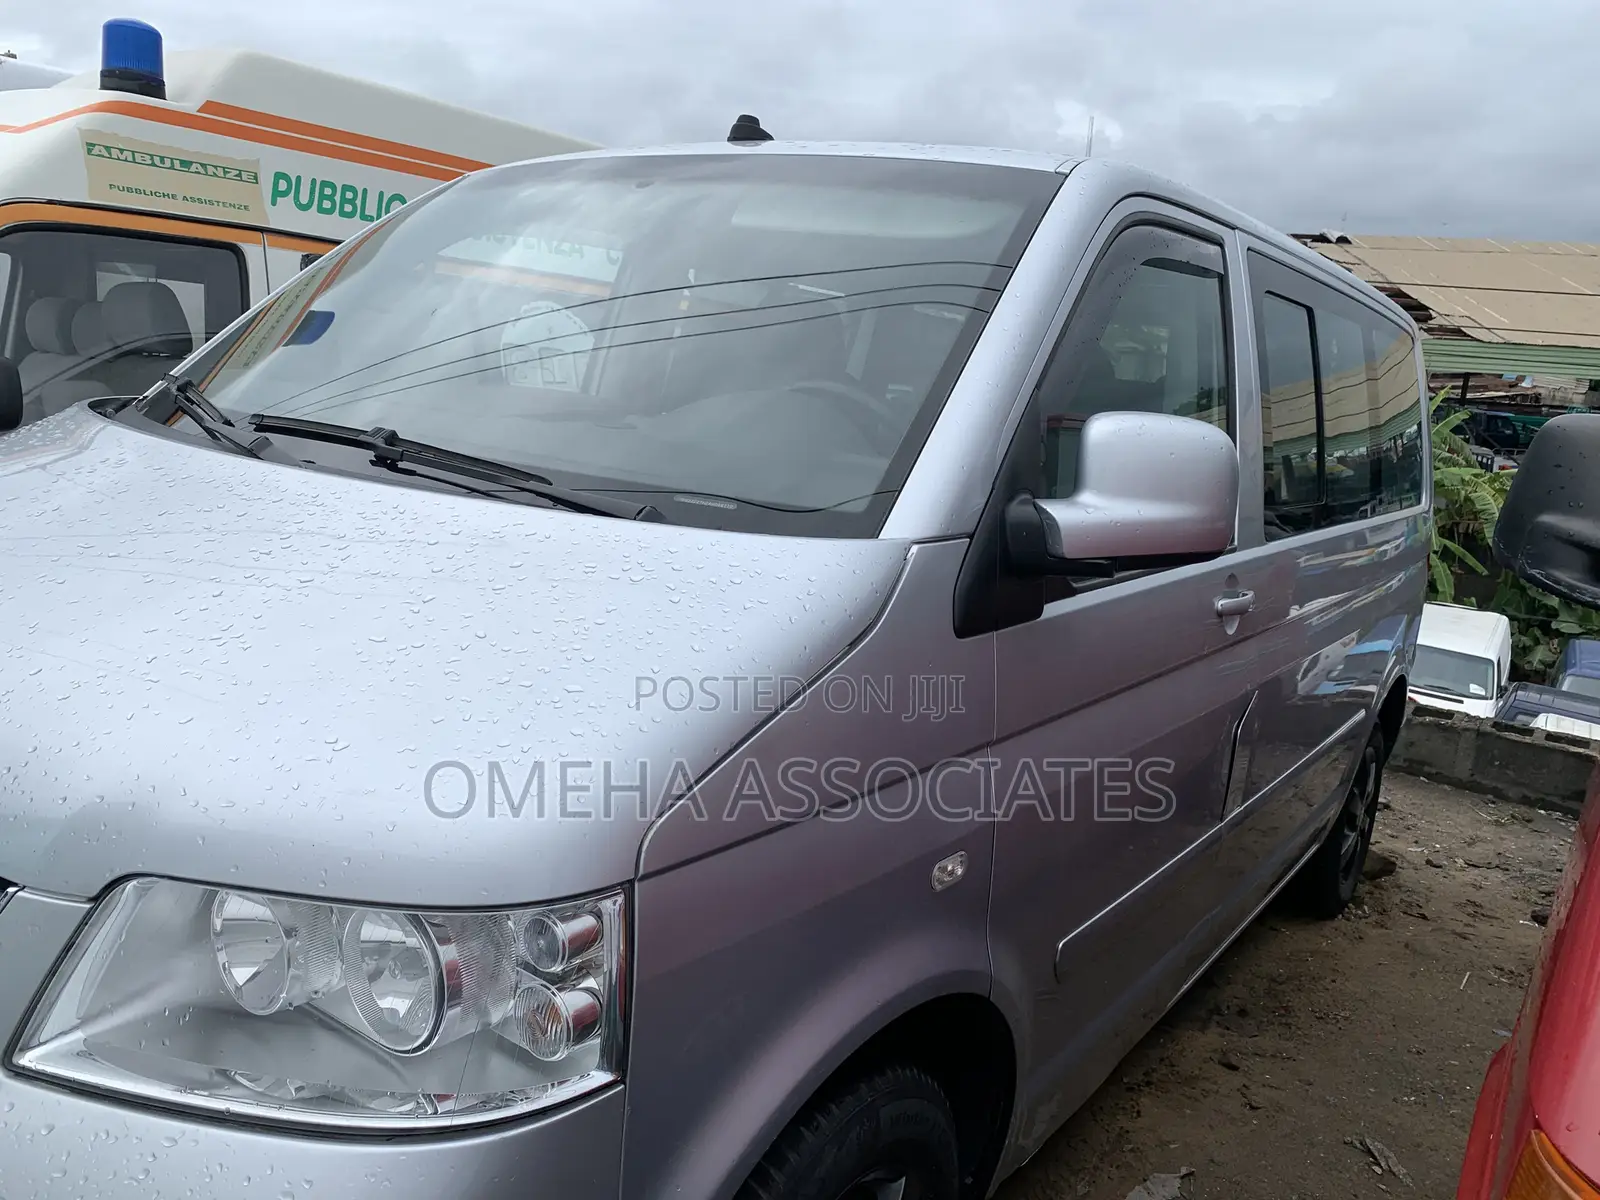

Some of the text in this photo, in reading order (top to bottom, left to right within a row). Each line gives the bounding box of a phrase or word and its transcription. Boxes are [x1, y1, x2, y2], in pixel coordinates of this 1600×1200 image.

[88, 144, 258, 184] AMBULANZE
[109, 183, 251, 212] PUBBLICHE ASSISTENZE
